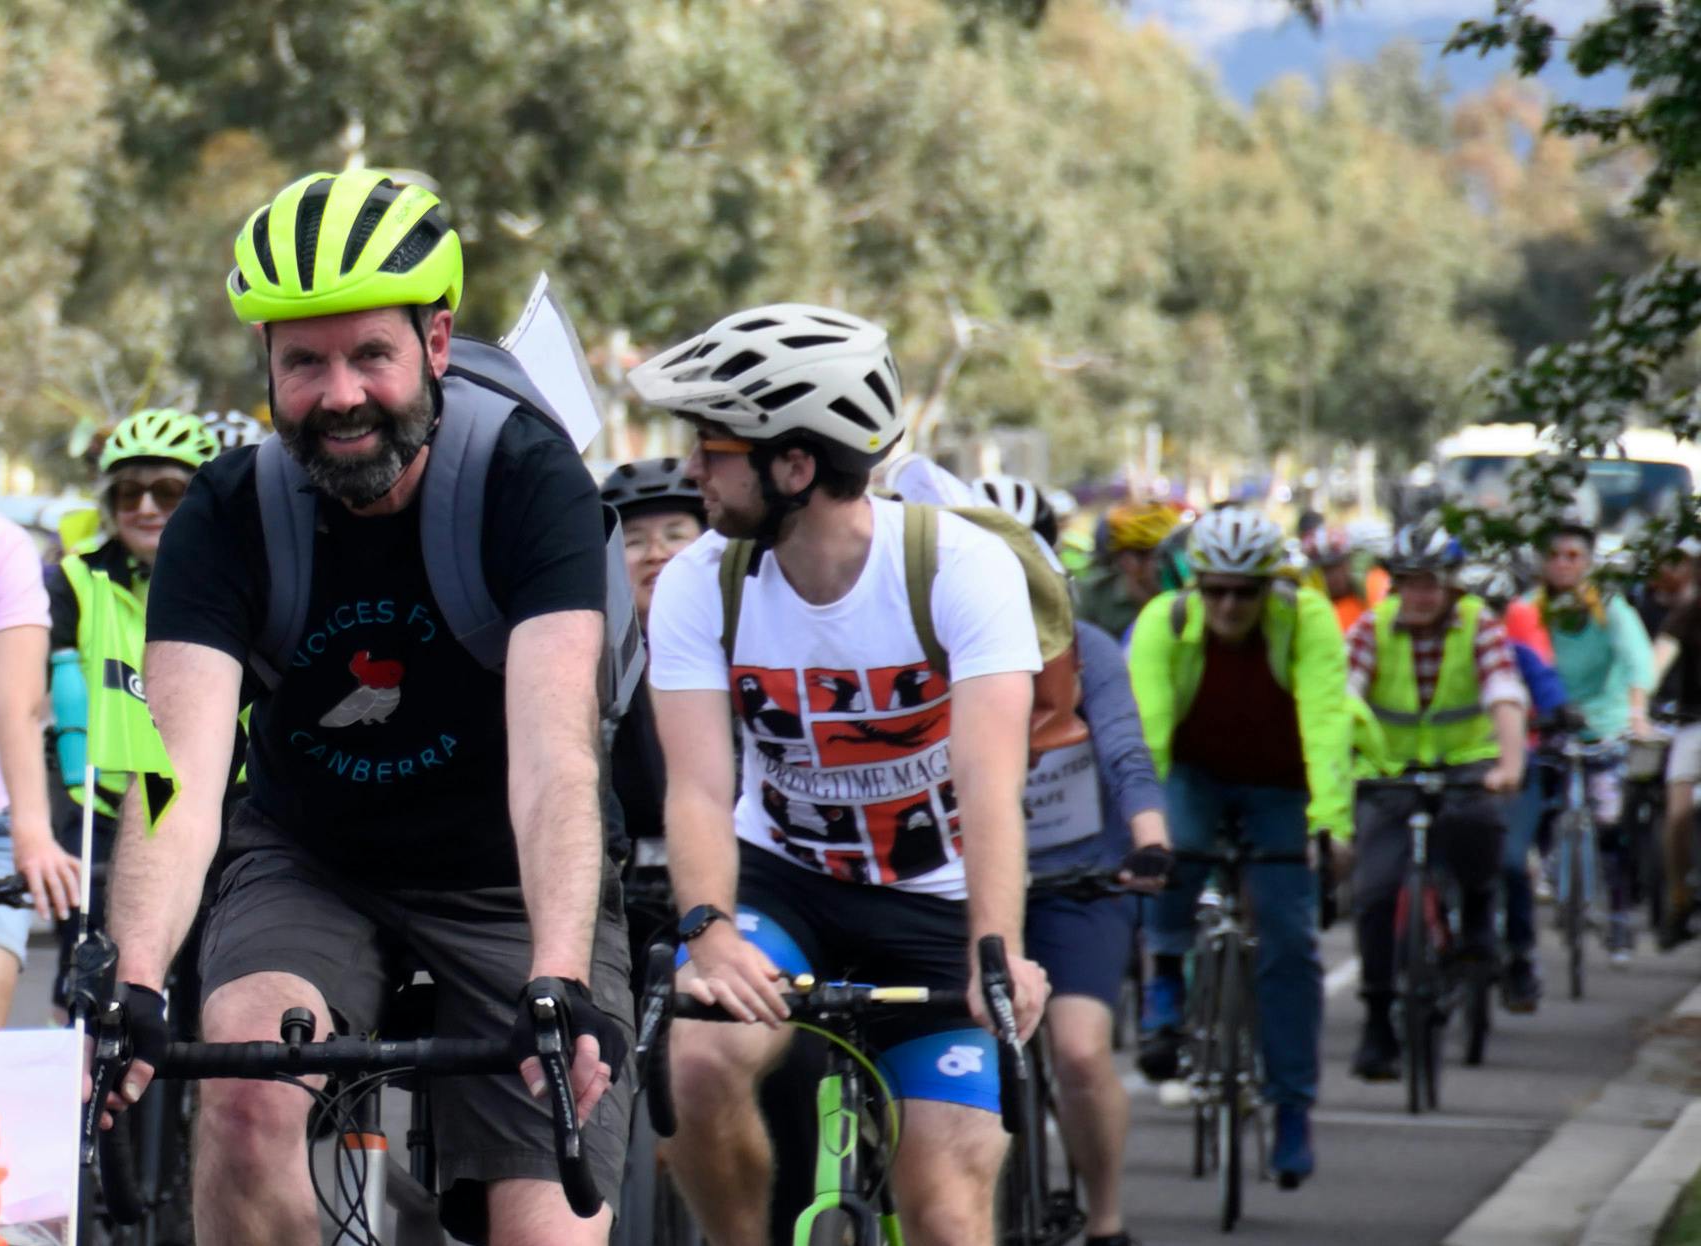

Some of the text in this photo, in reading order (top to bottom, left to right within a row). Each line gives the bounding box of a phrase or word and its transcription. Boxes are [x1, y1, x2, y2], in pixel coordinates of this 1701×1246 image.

[292, 600, 396, 668] VOICES
[290, 730, 458, 784] CANBERRA
[893, 746, 950, 794] MAG
[1026, 756, 1092, 788] ARATED
[85, 1063, 106, 1136] ULTEGRA
[549, 1057, 574, 1130] ULTEGRA
